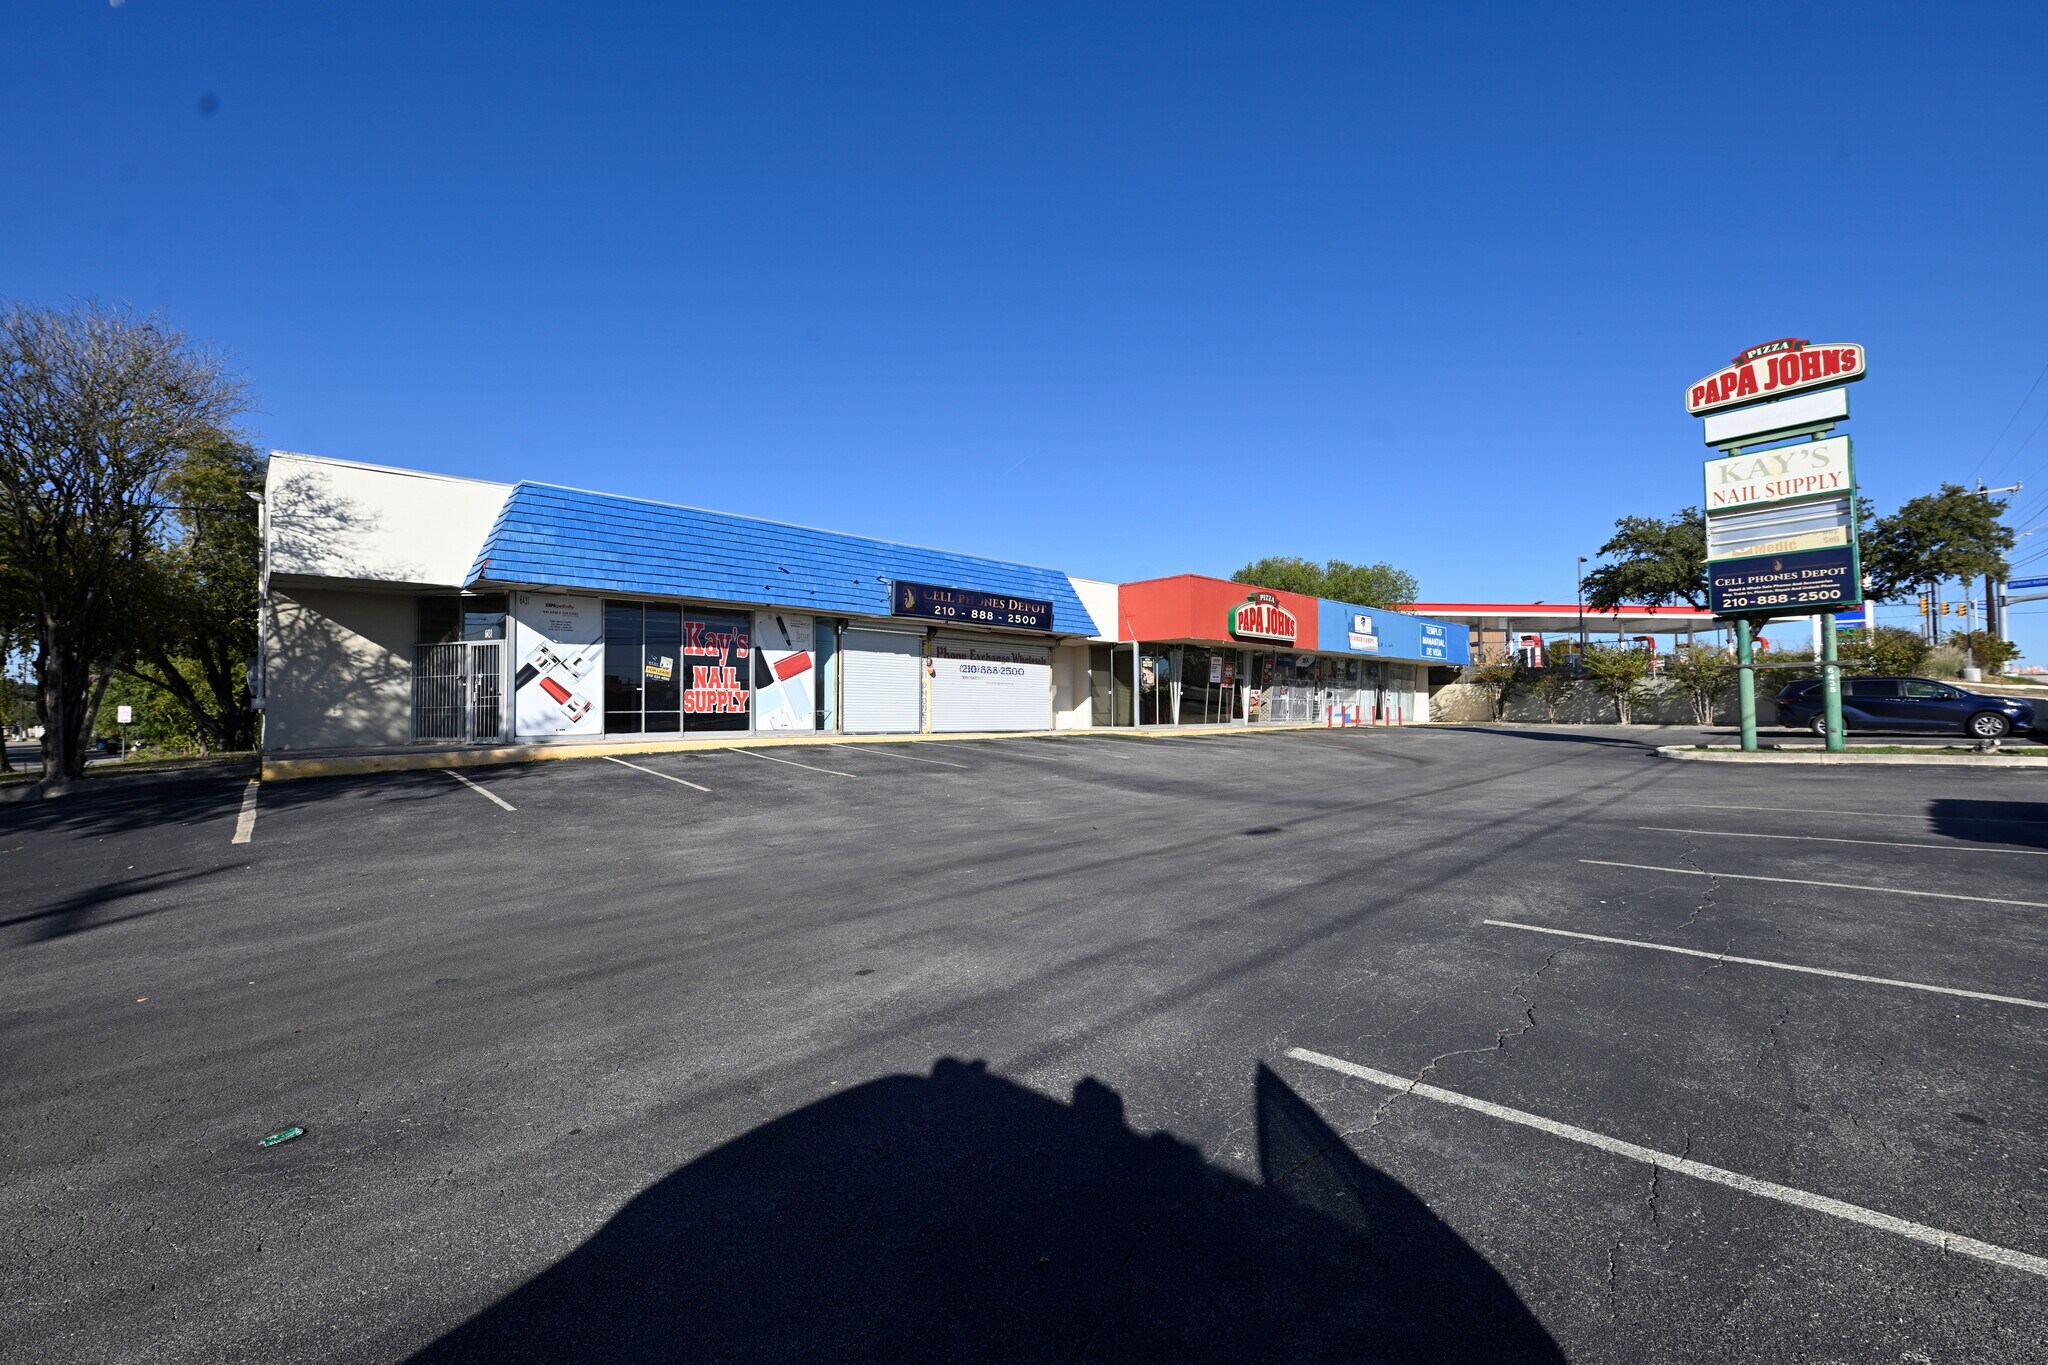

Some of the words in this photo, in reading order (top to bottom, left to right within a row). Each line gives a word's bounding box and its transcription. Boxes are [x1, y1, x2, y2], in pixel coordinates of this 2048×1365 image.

[1747, 341, 1790, 359] PIZZA
[1692, 364, 1759, 408] PAPA
[1719, 446, 1831, 485] KAY'S
[1713, 485, 1760, 506] NAIL
[1765, 471, 1843, 498] SUPPLY
[1756, 541, 1797, 554] Medic
[1715, 577, 1745, 587] CELL
[1748, 572, 1798, 584] PHONES
[1801, 566, 1848, 579] DEPOT
[1008, 599, 1047, 614] DEPOT
[1260, 594, 1275, 603] PIZZA
[1238, 606, 1264, 633] PAPA
[1426, 626, 1442, 636] TEMPLO
[684, 621, 748, 667] Kay's
[936, 646, 966, 659] Phone
[969, 649, 1006, 663] Exchange
[1426, 647, 1433, 656] DE
[1433, 648, 1442, 656] VIDA
[693, 666, 740, 689] NAIL
[684, 689, 749, 713] SUPPLY
